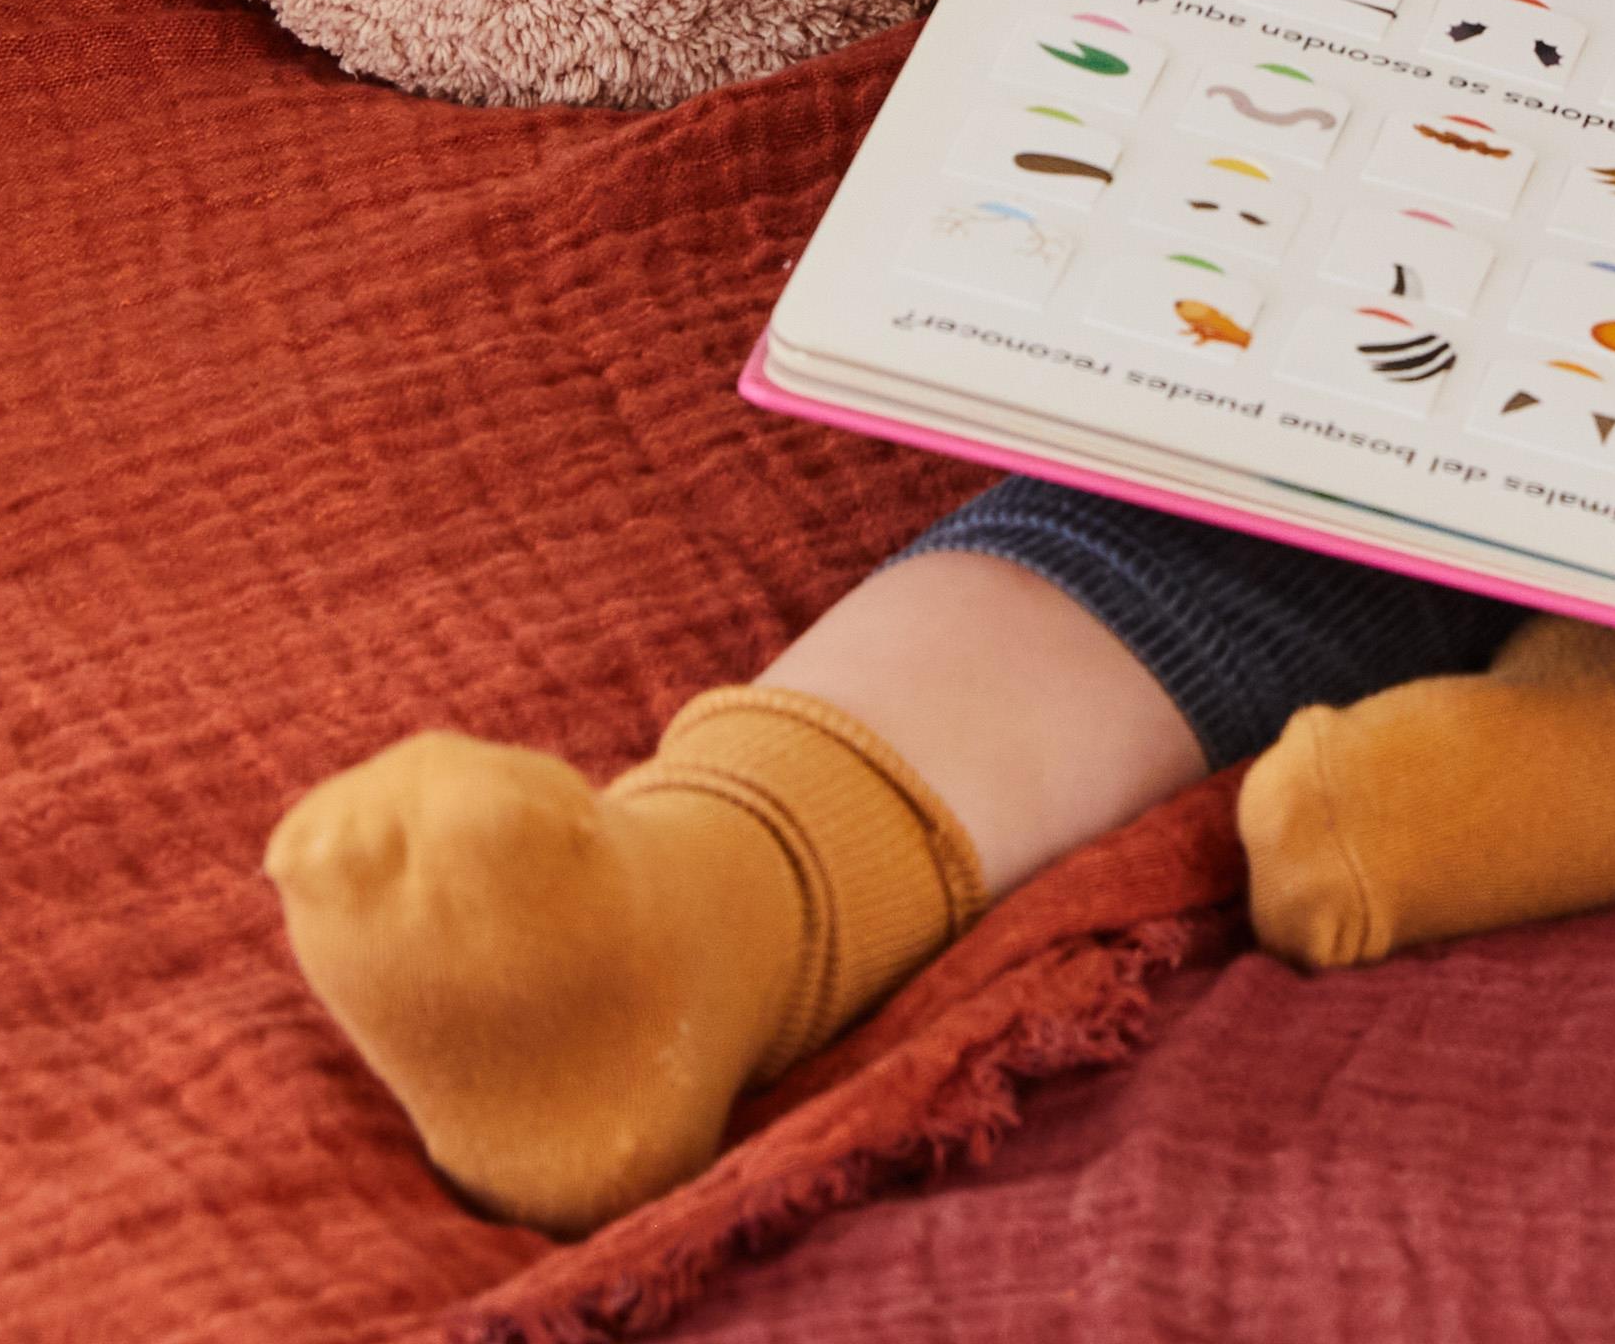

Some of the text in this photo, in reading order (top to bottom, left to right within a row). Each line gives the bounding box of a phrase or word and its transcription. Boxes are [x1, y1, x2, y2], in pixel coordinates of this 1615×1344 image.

[1261, 21, 1432, 80] esconden
[1448, 75, 1490, 95] se
[892, 309, 1111, 377] reconocer?
[1126, 369, 1265, 419] puedes
[1279, 413, 1417, 466] bosque
[1428, 456, 1490, 483] del
